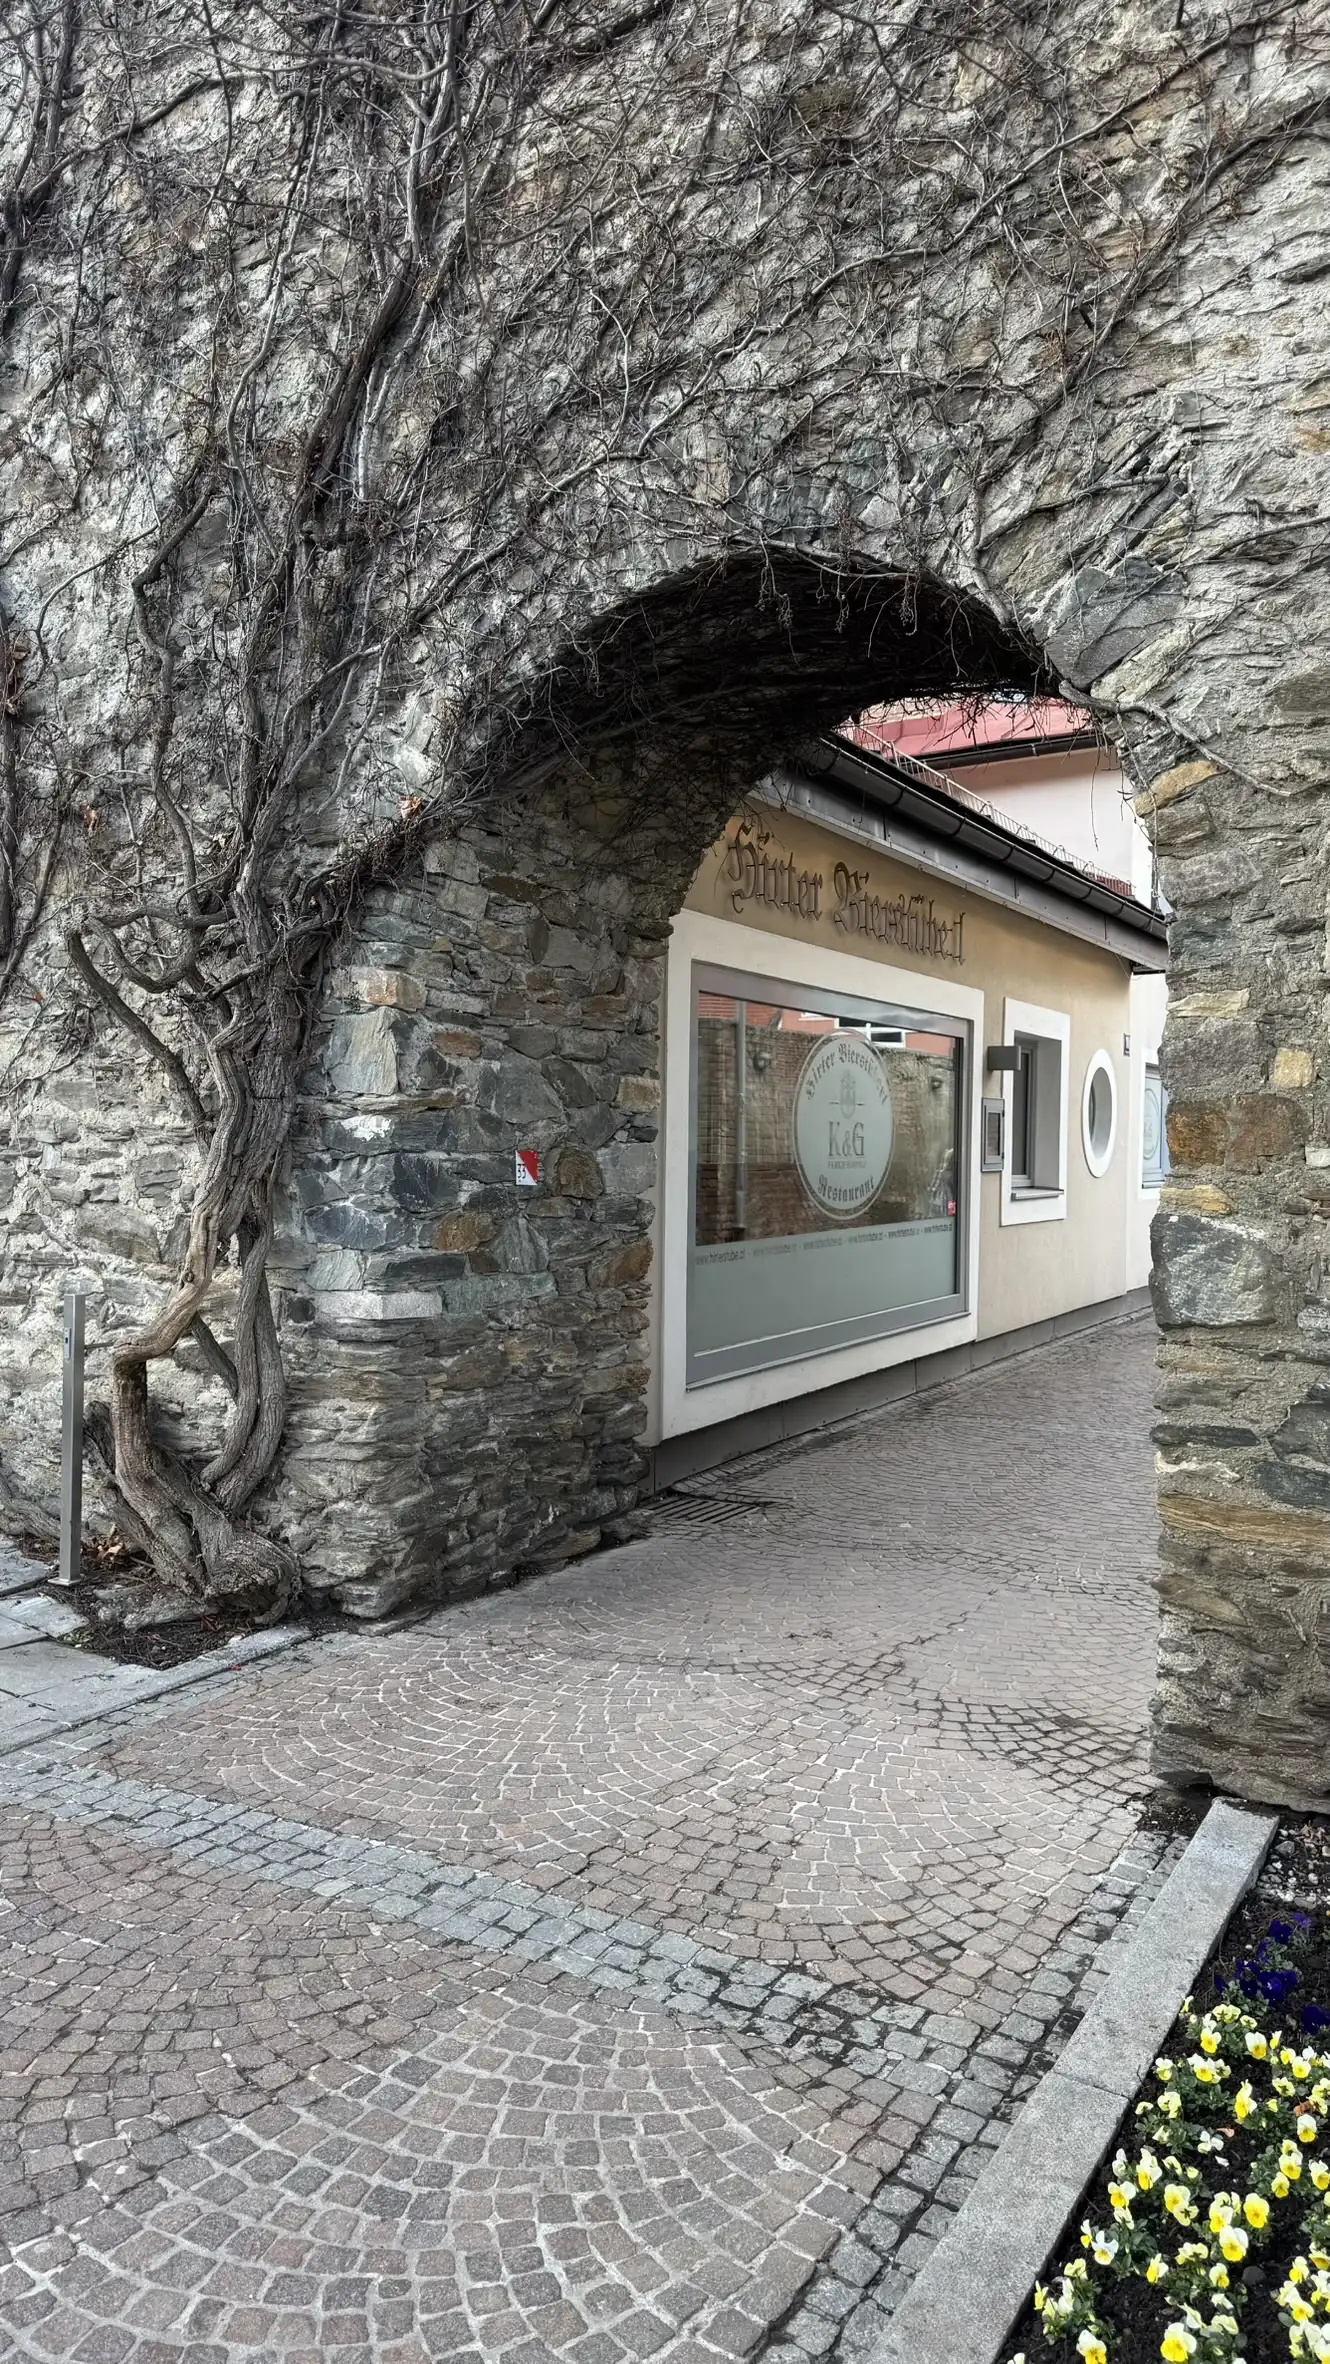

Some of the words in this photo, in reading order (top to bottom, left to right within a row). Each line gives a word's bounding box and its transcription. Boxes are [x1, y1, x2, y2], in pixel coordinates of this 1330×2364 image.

[727, 822, 823, 921] Hirter
[833, 861, 966, 966] Bierstübel
[828, 1121, 865, 1157] K&G
[818, 1174, 874, 1202] Restaurant
